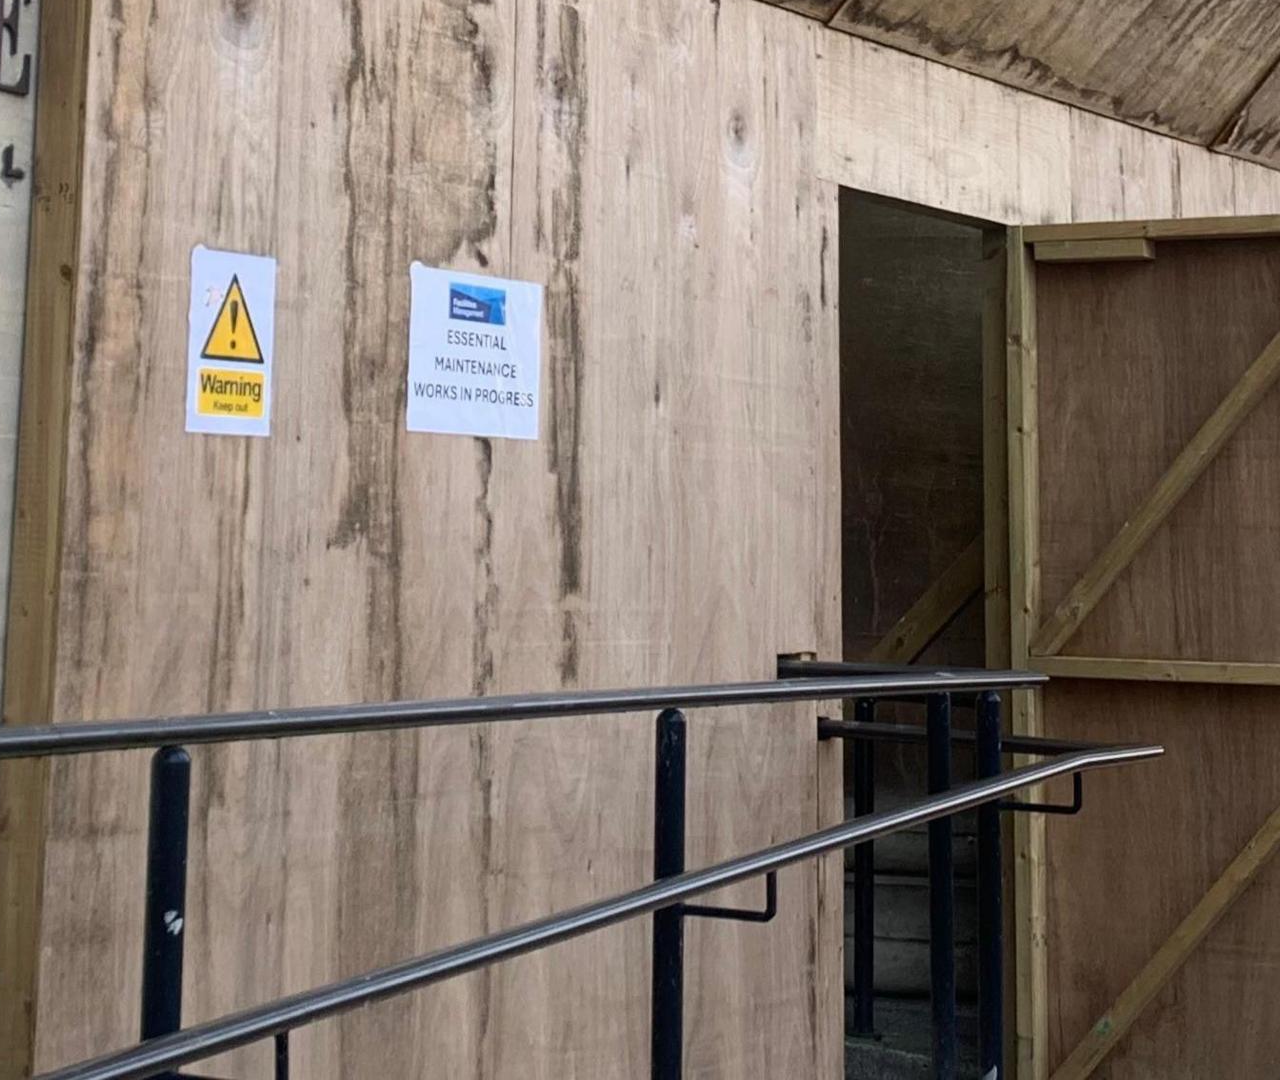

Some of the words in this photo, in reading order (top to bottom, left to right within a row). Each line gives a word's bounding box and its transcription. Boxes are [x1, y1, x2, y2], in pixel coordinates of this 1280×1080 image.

[447, 329, 507, 351] ESSENTIAL
[434, 356, 517, 379] MAINTENANCE
[200, 373, 262, 402] Warning
[413, 381, 458, 400] WORKS
[460, 386, 472, 401] IN
[474, 387, 534, 408] PROGRESS
[235, 403, 249, 412] out
